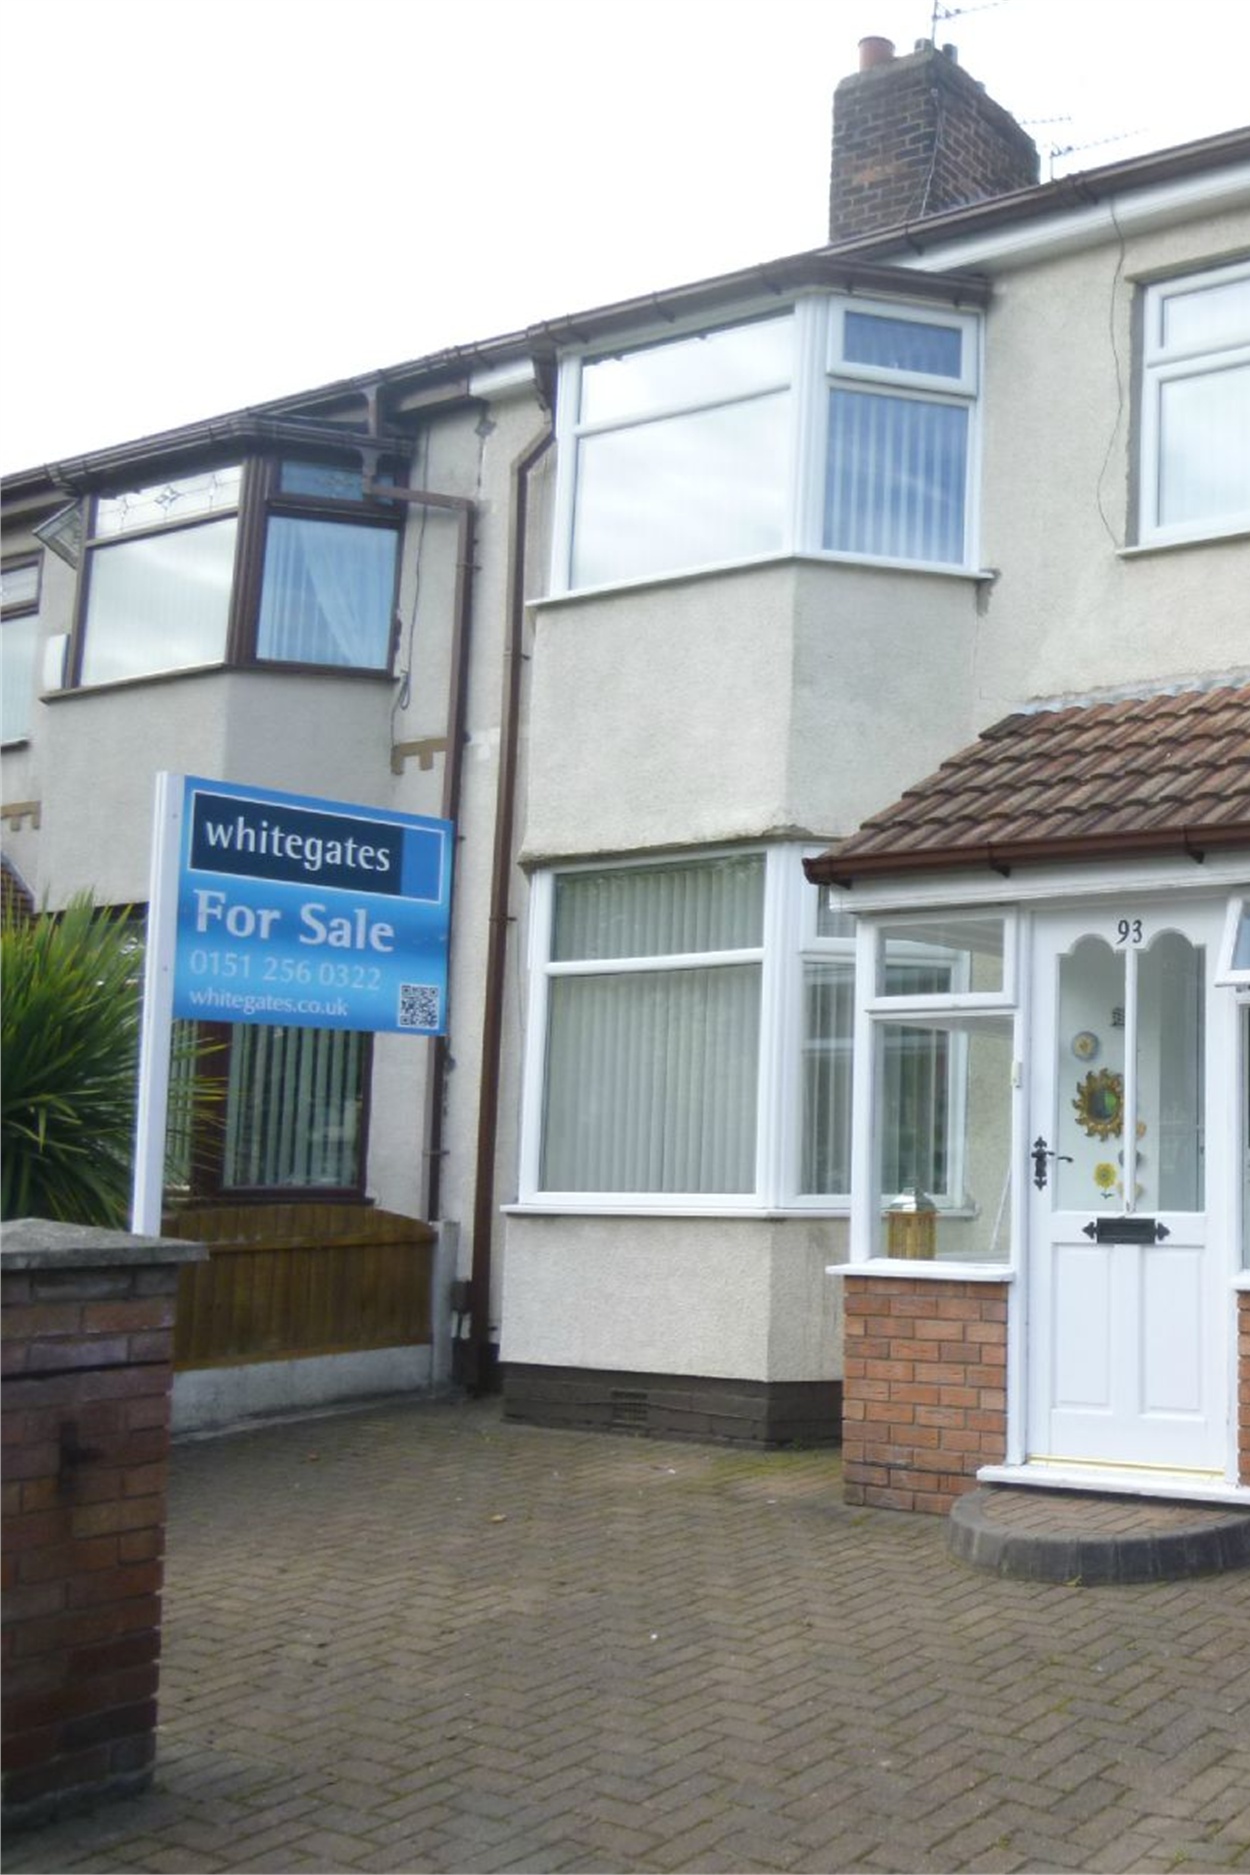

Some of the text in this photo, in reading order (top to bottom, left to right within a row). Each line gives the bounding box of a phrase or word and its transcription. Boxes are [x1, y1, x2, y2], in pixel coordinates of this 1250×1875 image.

[206, 816, 391, 871] whitegates
[194, 889, 395, 952] For Sale
[1117, 919, 1143, 944] 93
[190, 949, 382, 990] 0151 256 0322
[189, 987, 348, 1016] whitegates.co.uk
